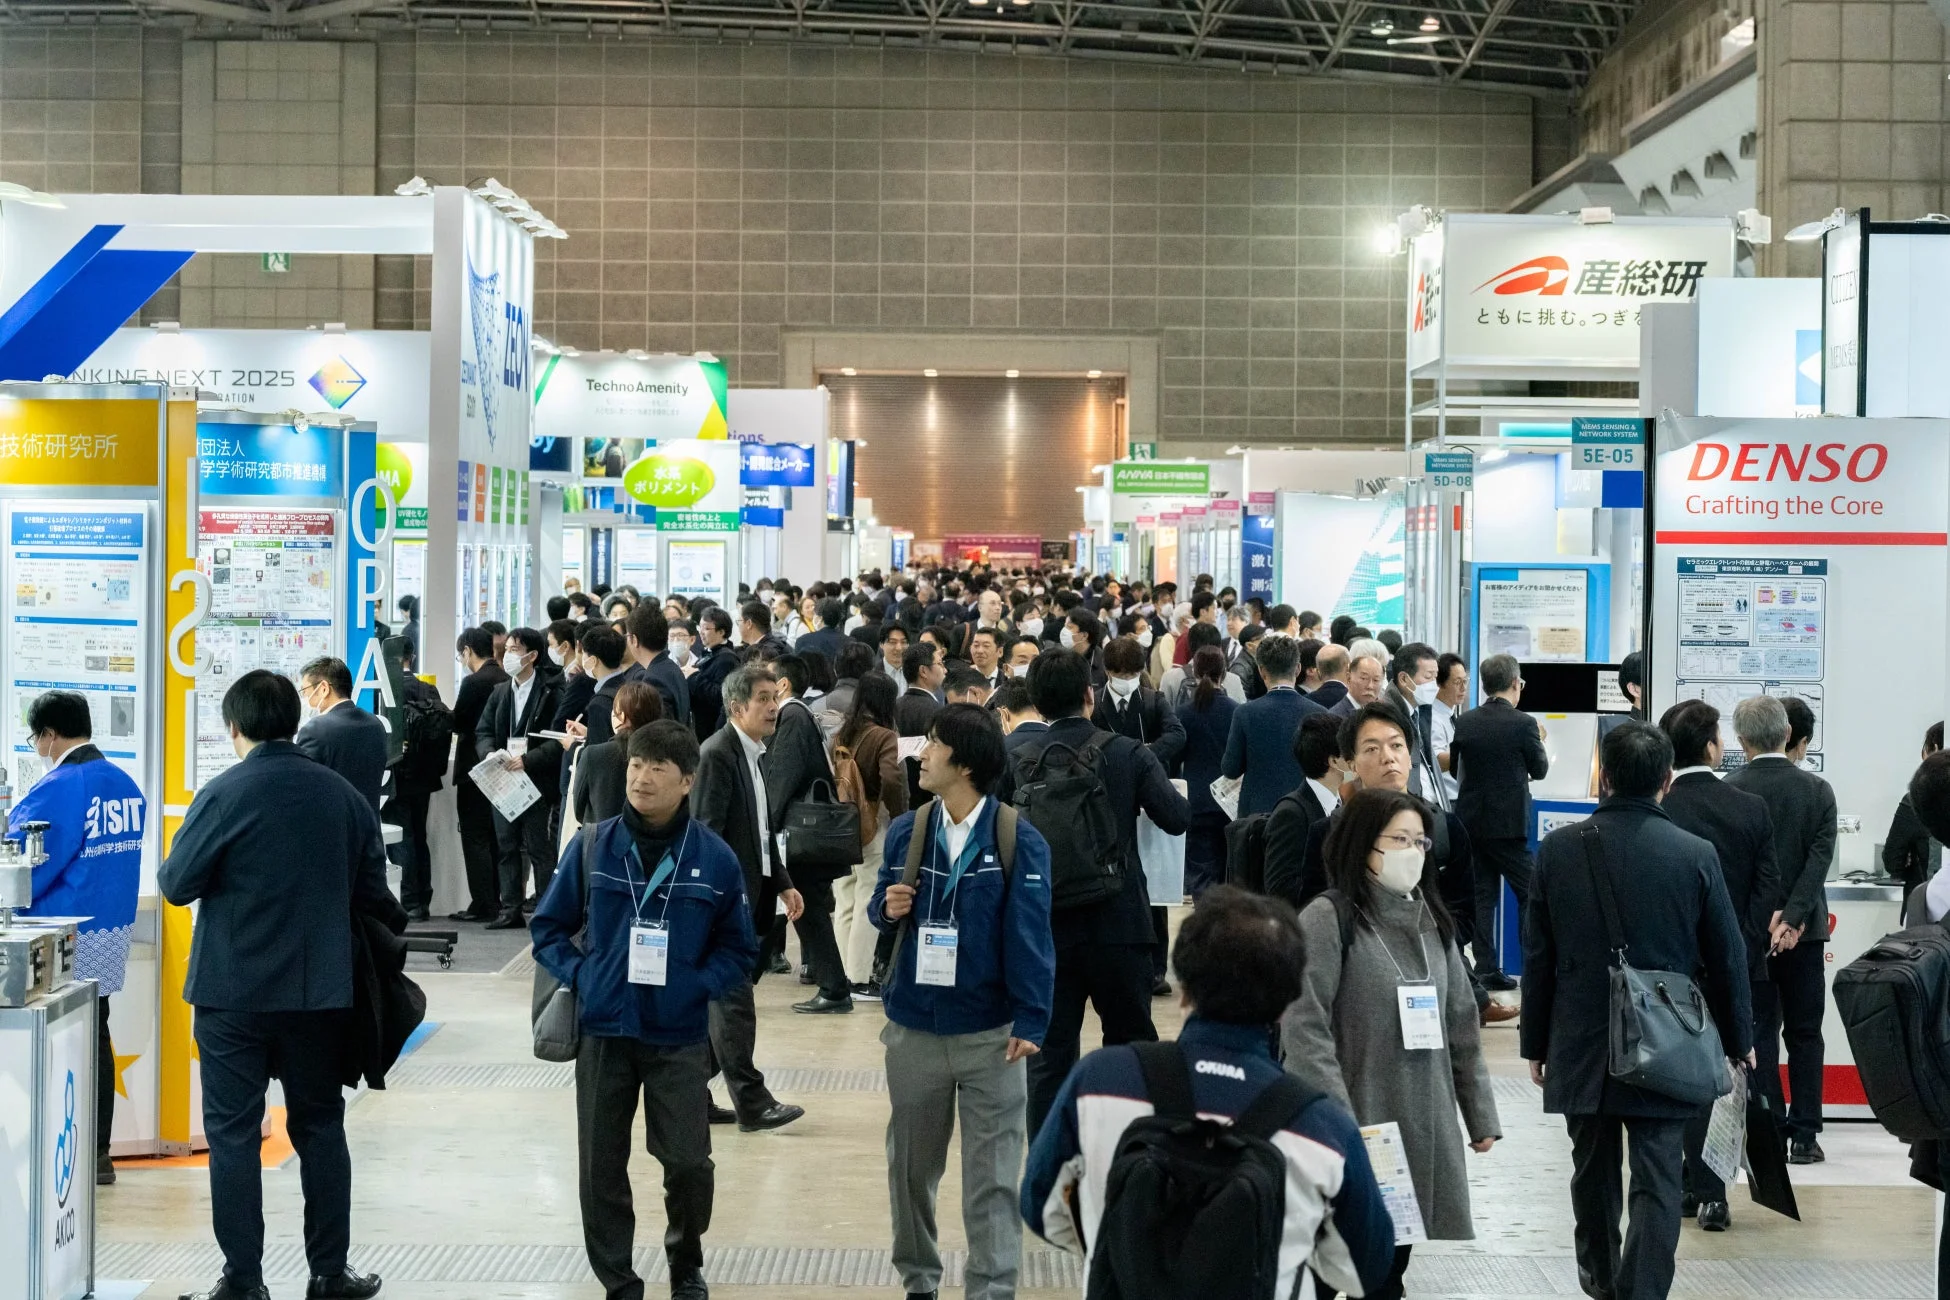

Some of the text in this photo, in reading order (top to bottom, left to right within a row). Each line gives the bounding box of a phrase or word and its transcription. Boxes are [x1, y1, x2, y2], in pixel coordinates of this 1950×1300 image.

[1574, 259, 1708, 297] 産総研
[72, 369, 295, 387] NKING NEXT 2025
[727, 430, 766, 443] tions
[0, 432, 119, 459] 技術研究所
[197, 437, 246, 457] 団法人
[1583, 448, 1634, 463] 5E-05
[1687, 443, 1889, 483] DENSO
[376, 470, 401, 487] MA
[1434, 475, 1472, 487] 5D-08
[634, 480, 700, 496] ポリメント
[1686, 495, 1884, 519] Crafting the Core
[103, 798, 142, 835] ISIT
[637, 935, 643, 944] 2
[926, 935, 932, 944] 2
[1407, 998, 1413, 1007] 2
[1195, 1060, 1246, 1081] OKURA
